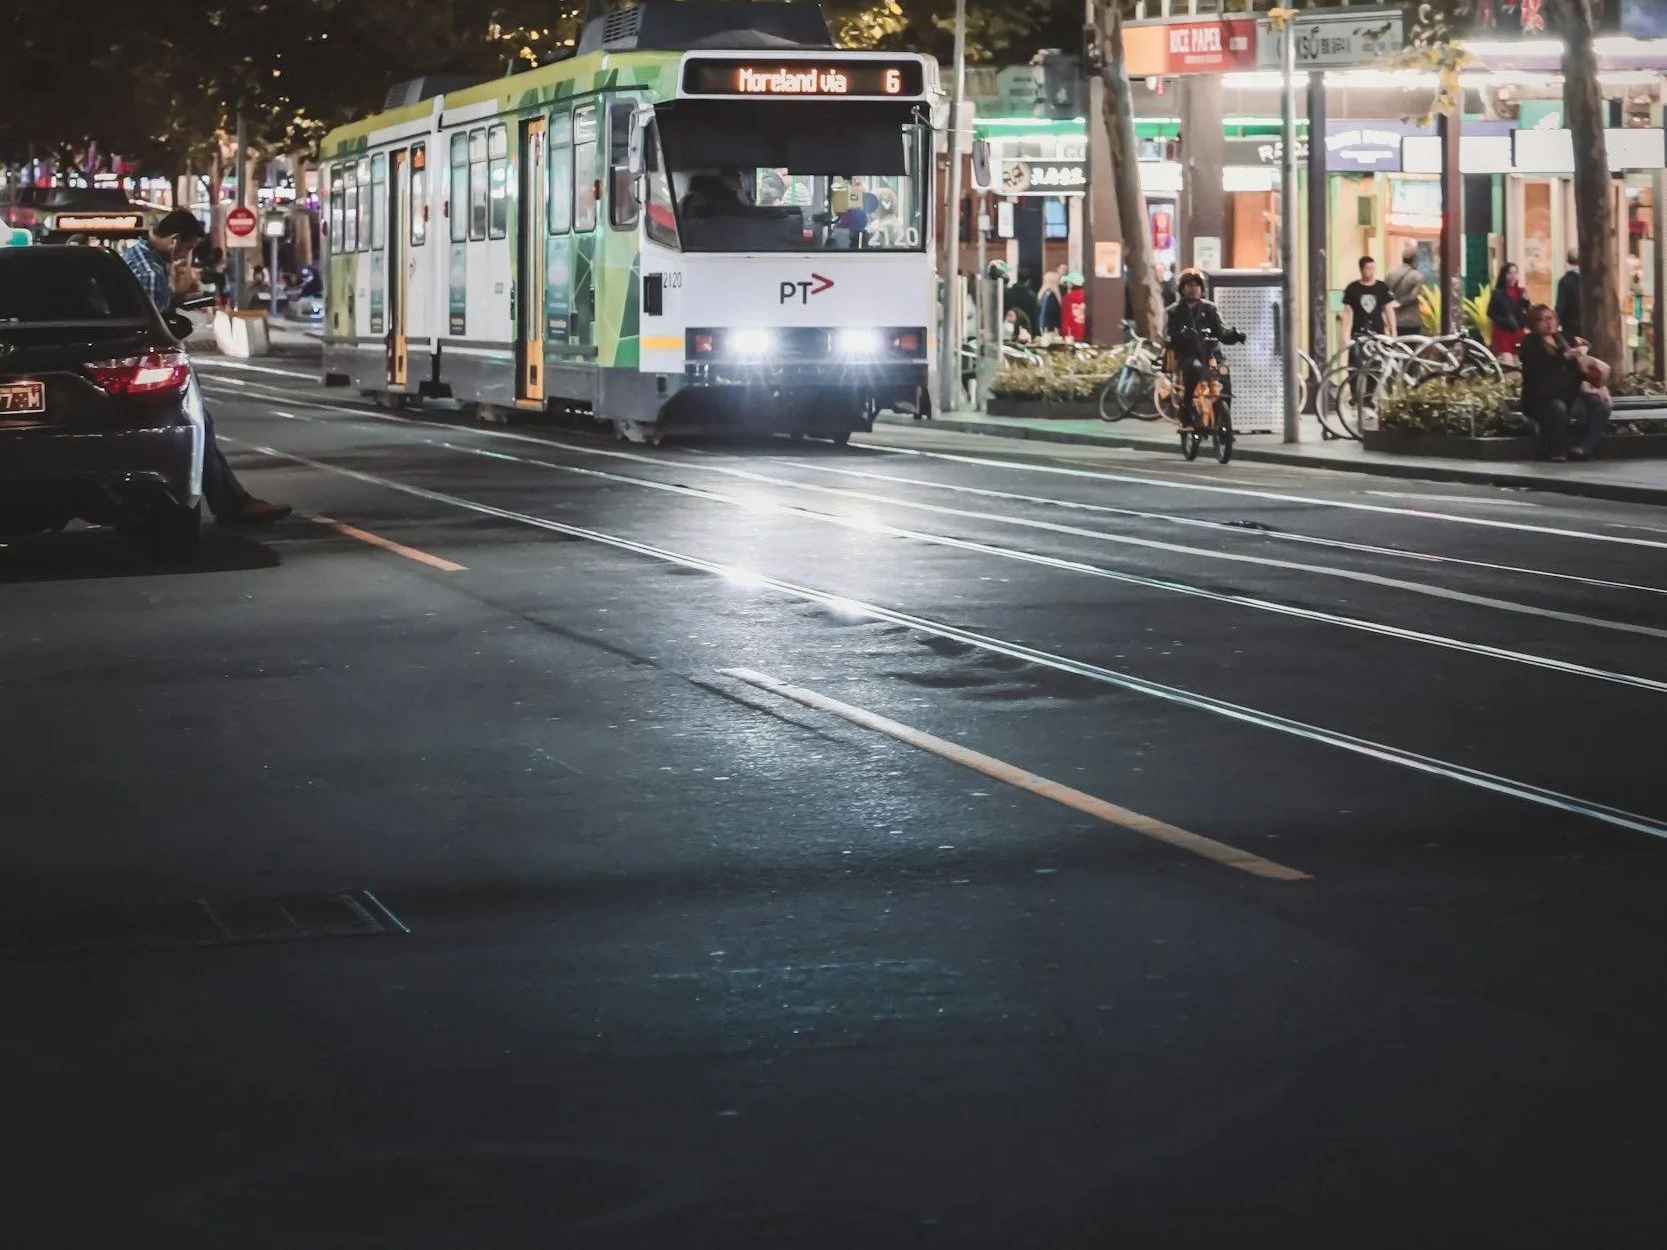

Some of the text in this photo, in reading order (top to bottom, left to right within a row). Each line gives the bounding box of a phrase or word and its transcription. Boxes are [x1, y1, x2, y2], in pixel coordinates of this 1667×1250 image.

[739, 68, 900, 94] Moreland via 6
[867, 226, 919, 247] 2120
[663, 271, 683, 289] 2120
